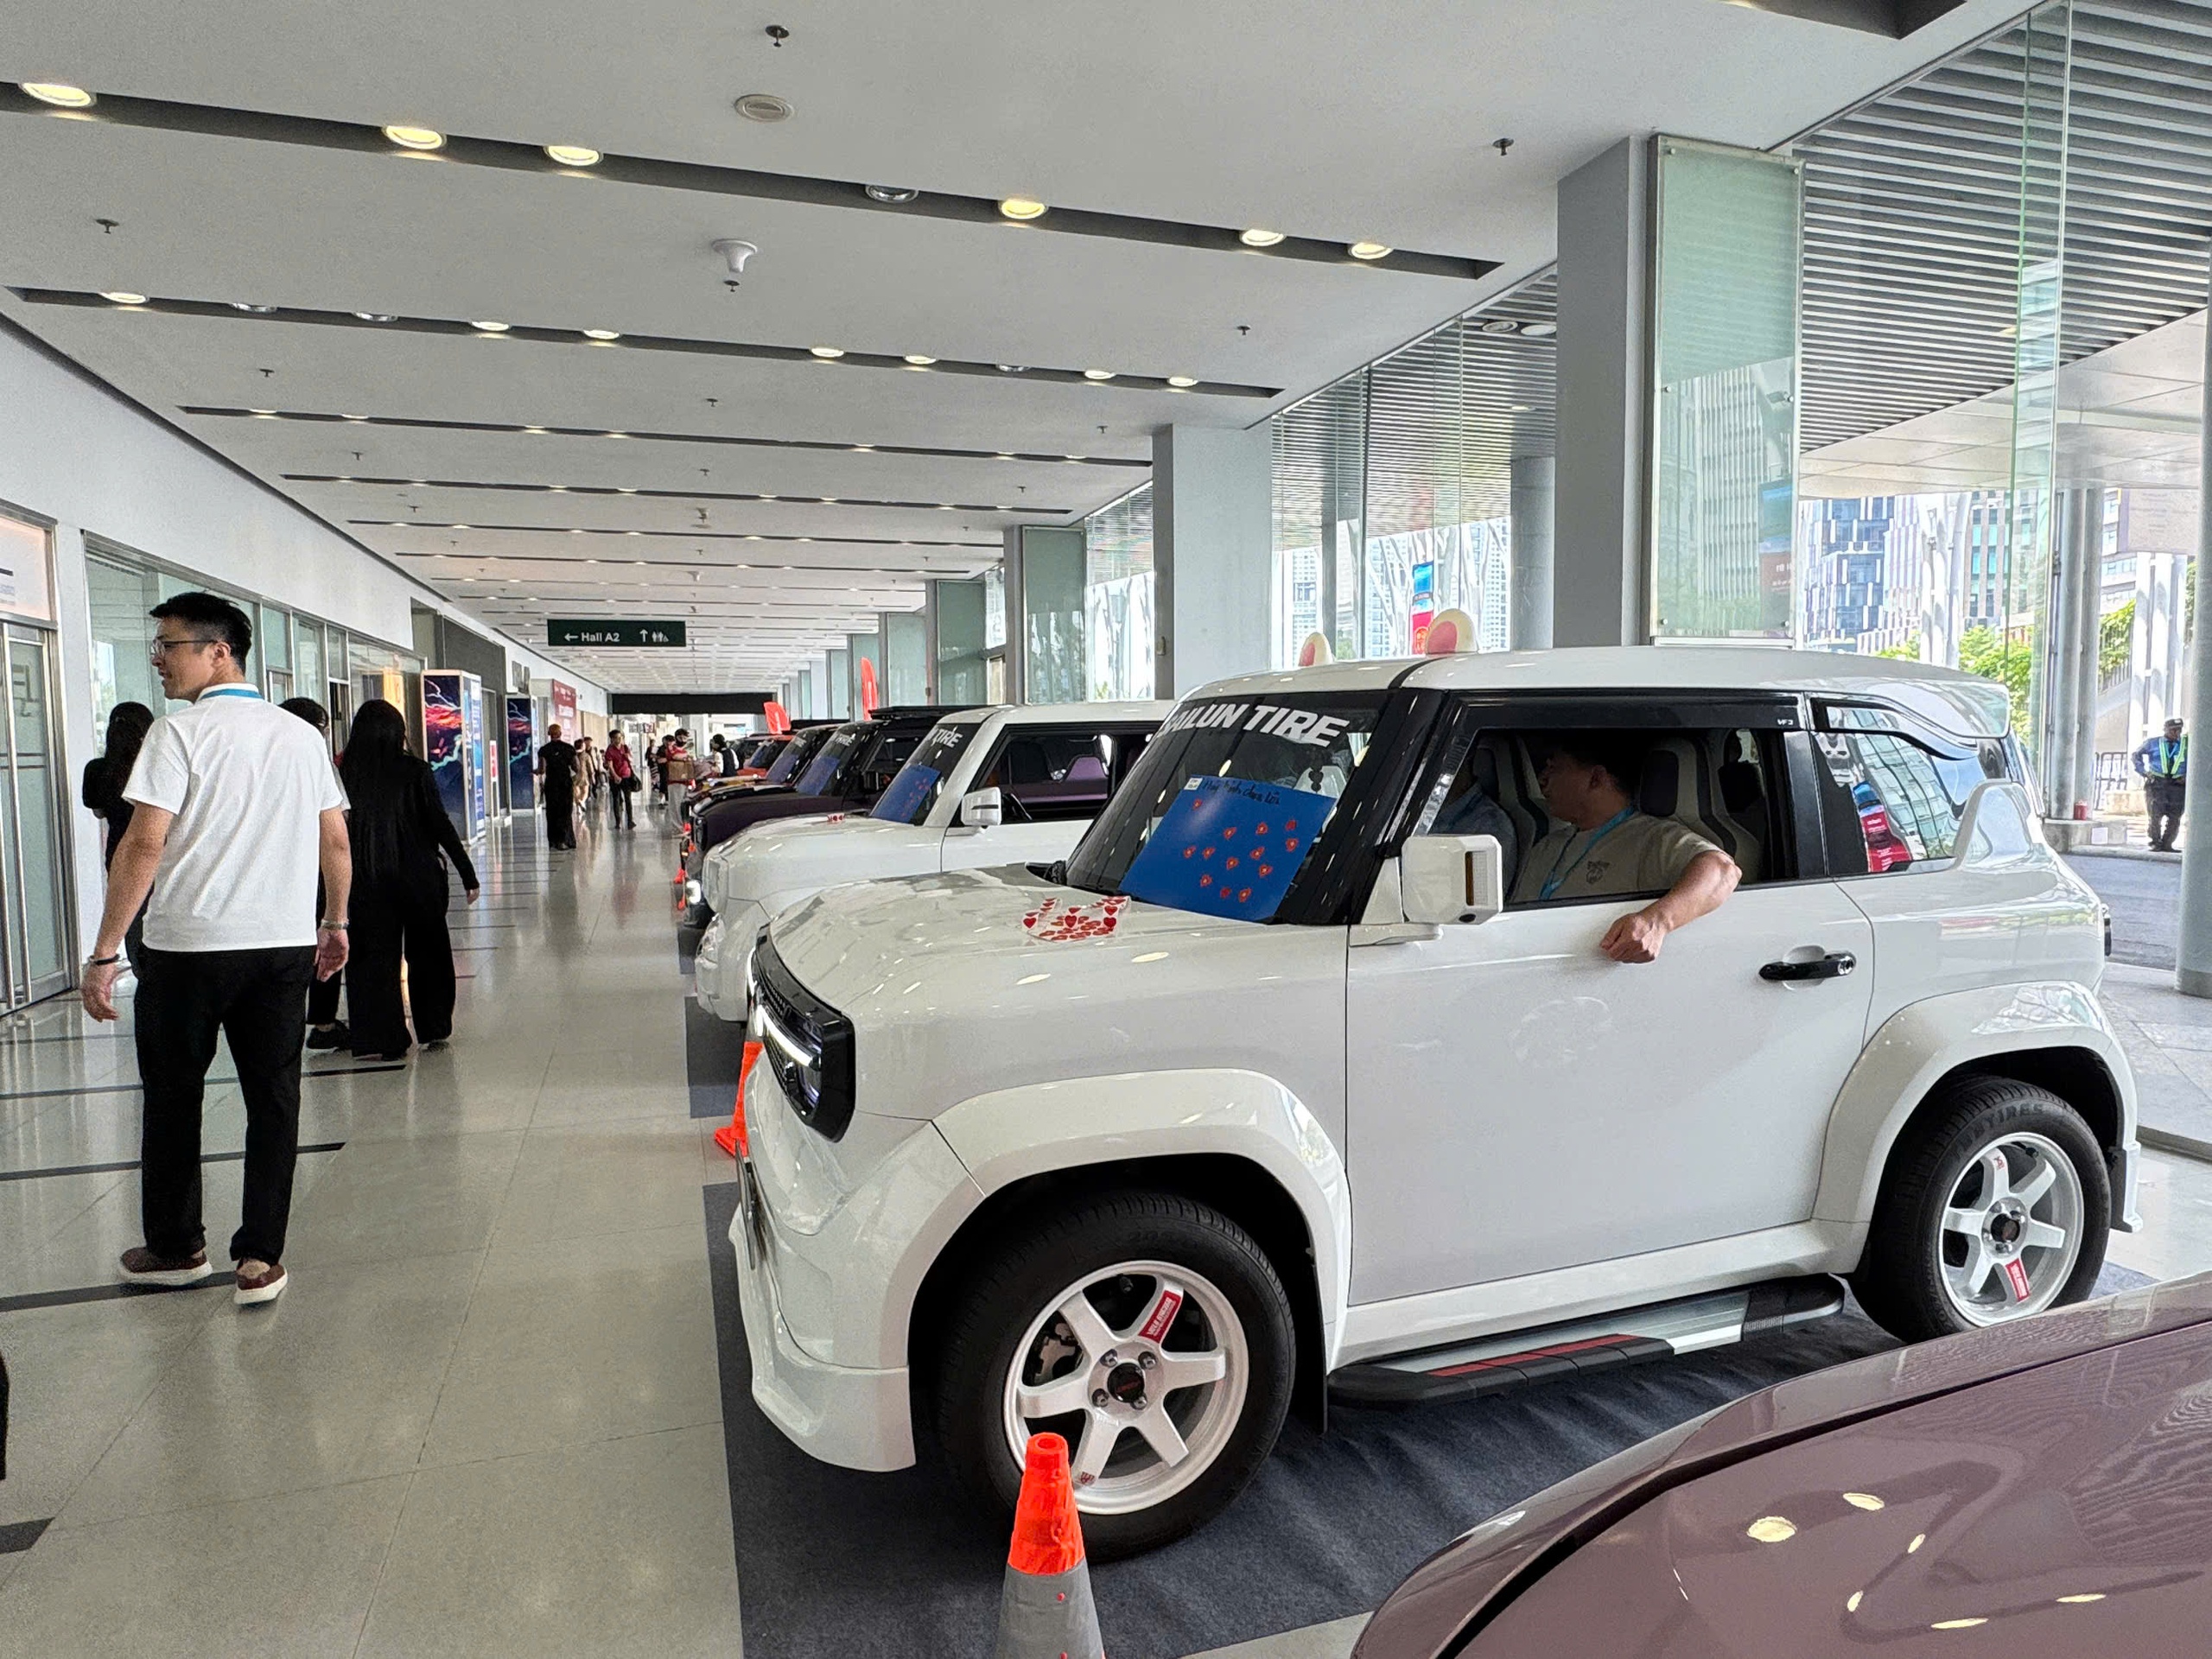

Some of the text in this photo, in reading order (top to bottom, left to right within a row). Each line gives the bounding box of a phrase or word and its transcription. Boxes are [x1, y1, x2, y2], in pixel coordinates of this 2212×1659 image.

[581, 632, 620, 642] Hall A2
[1243, 705, 1351, 747] TIRE
